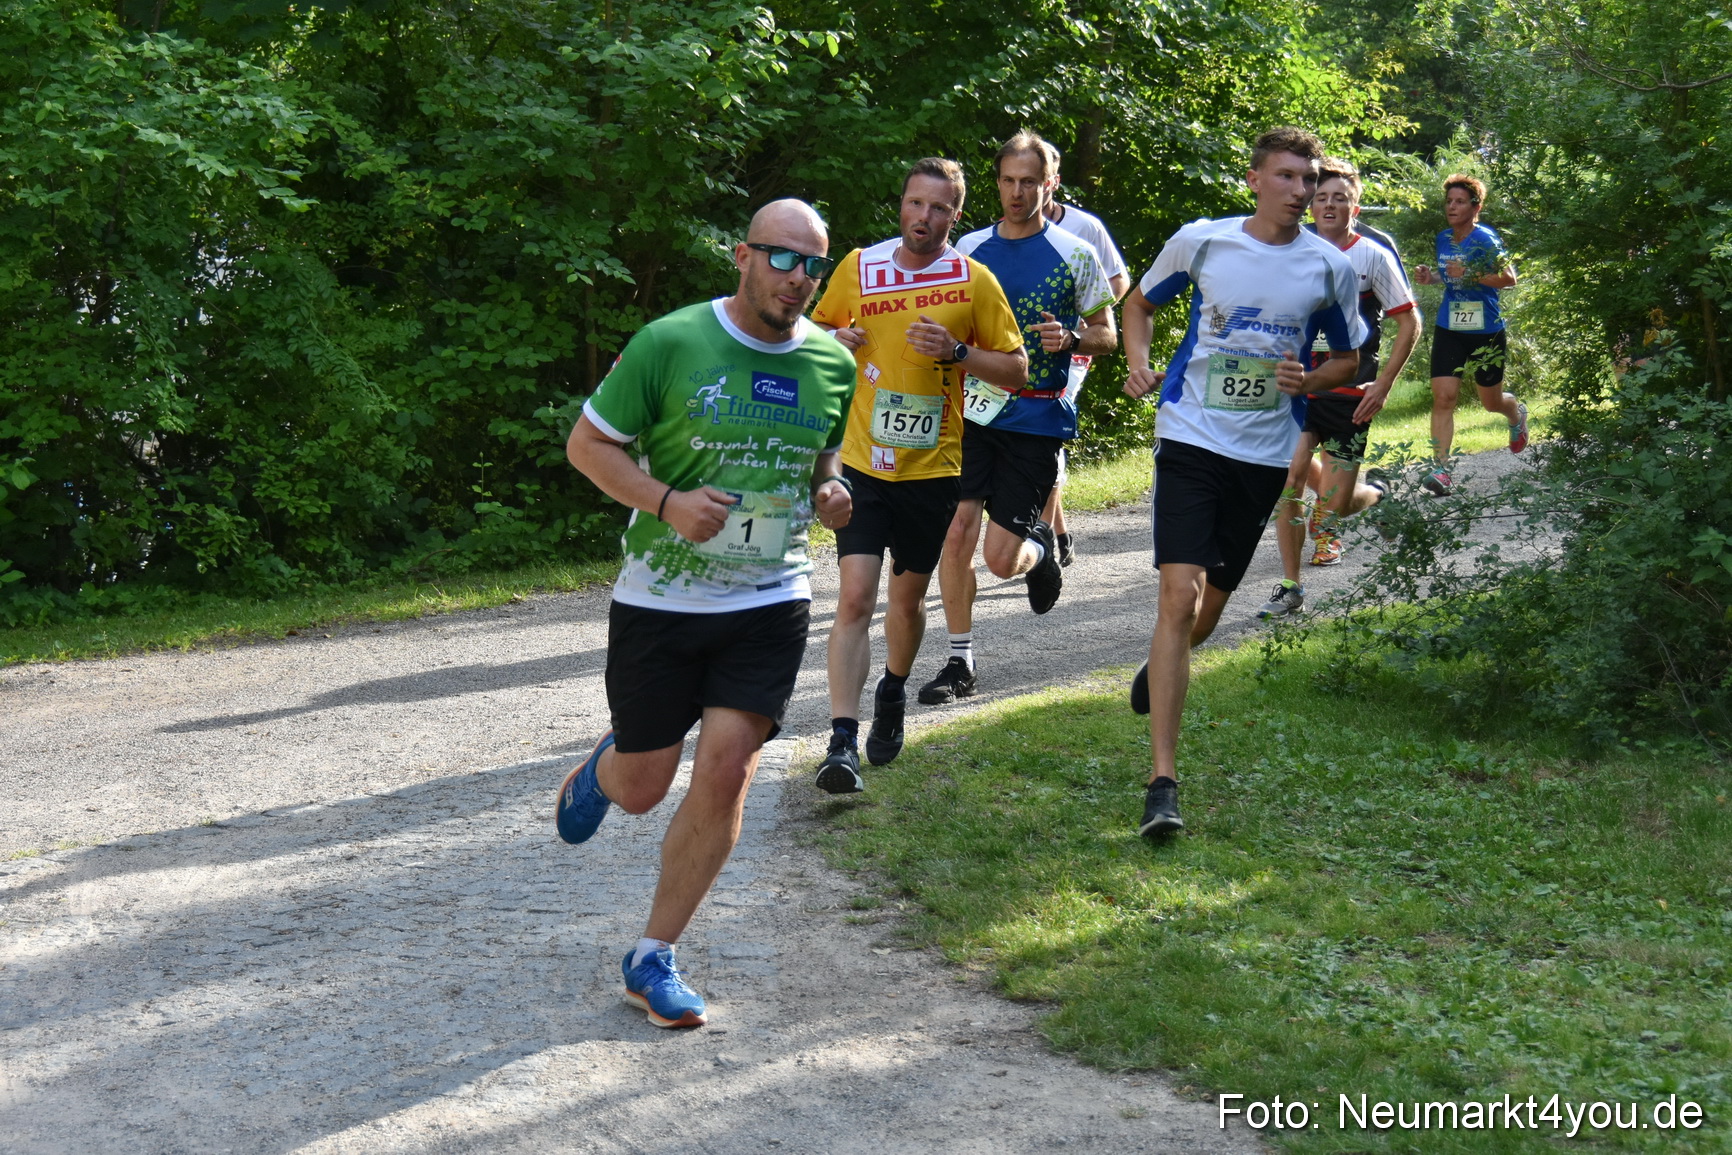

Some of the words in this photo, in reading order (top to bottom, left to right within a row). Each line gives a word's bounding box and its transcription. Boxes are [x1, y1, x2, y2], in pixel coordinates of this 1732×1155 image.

[860, 297, 908, 318] MAX
[915, 289, 971, 309] BÖGL
[1215, 305, 1301, 340] FORSTER
[1454, 311, 1474, 323] 727
[688, 370, 704, 384] 10
[707, 362, 737, 380] Jahre
[761, 384, 796, 398] Fischer
[1222, 377, 1266, 398] 825
[728, 395, 833, 433] firmenlauf
[880, 410, 933, 434] 1570
[728, 417, 777, 430] neumarkt
[884, 430, 901, 438] Fuchs
[690, 436, 759, 451] Gesunde
[719, 452, 768, 467] laufen
[741, 518, 754, 543] 1
[728, 543, 744, 551] Graf
[745, 544, 761, 553] Jörg
